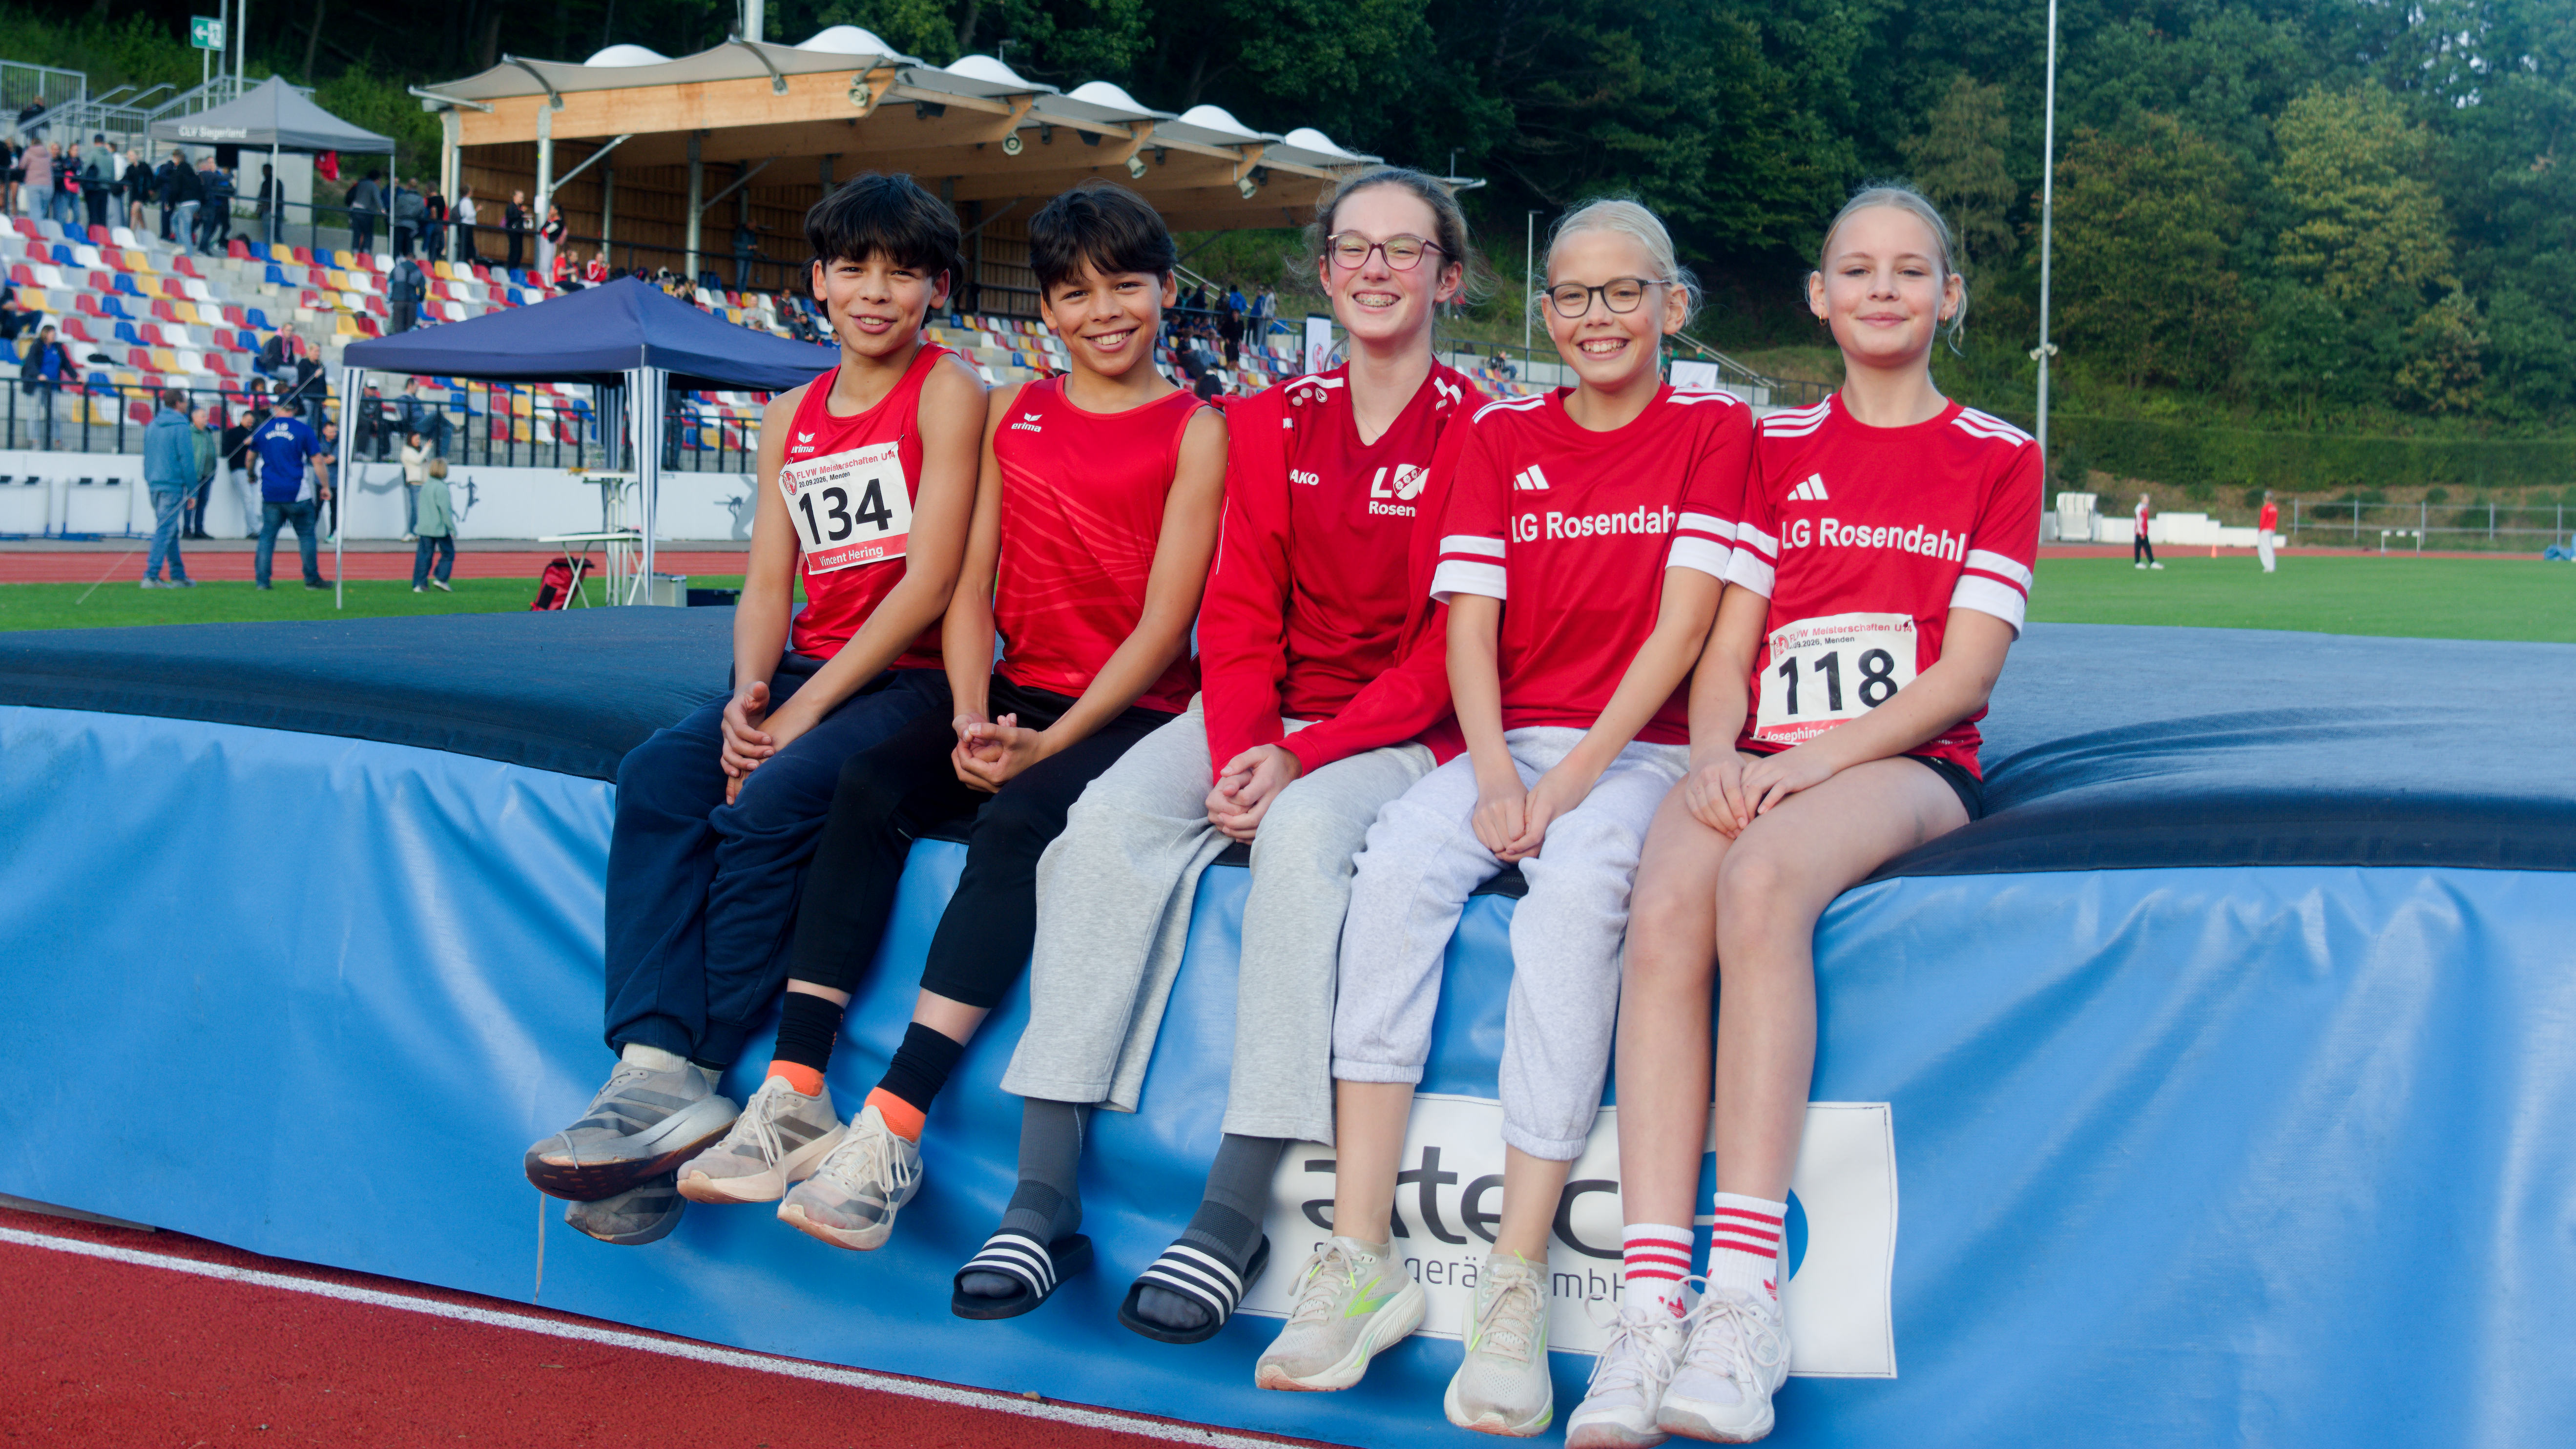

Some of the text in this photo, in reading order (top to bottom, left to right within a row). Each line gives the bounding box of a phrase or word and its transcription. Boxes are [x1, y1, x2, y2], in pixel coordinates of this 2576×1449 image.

[1011, 422, 1041, 433] erima
[796, 451, 895, 479] FLVW Meisterschaften U14
[799, 476, 828, 488] 20.09.2026,
[830, 472, 850, 481] Menden
[1289, 469, 1319, 485] AKO
[799, 478, 893, 545] 134
[1512, 505, 1676, 543] LG Rosendah
[1782, 518, 1966, 562] LG Rosendahl
[819, 546, 884, 567] Vincent Hering
[1812, 623, 1890, 636] Meisterschaften
[1825, 636, 1855, 644] Menden
[1779, 647, 1898, 715] 118
